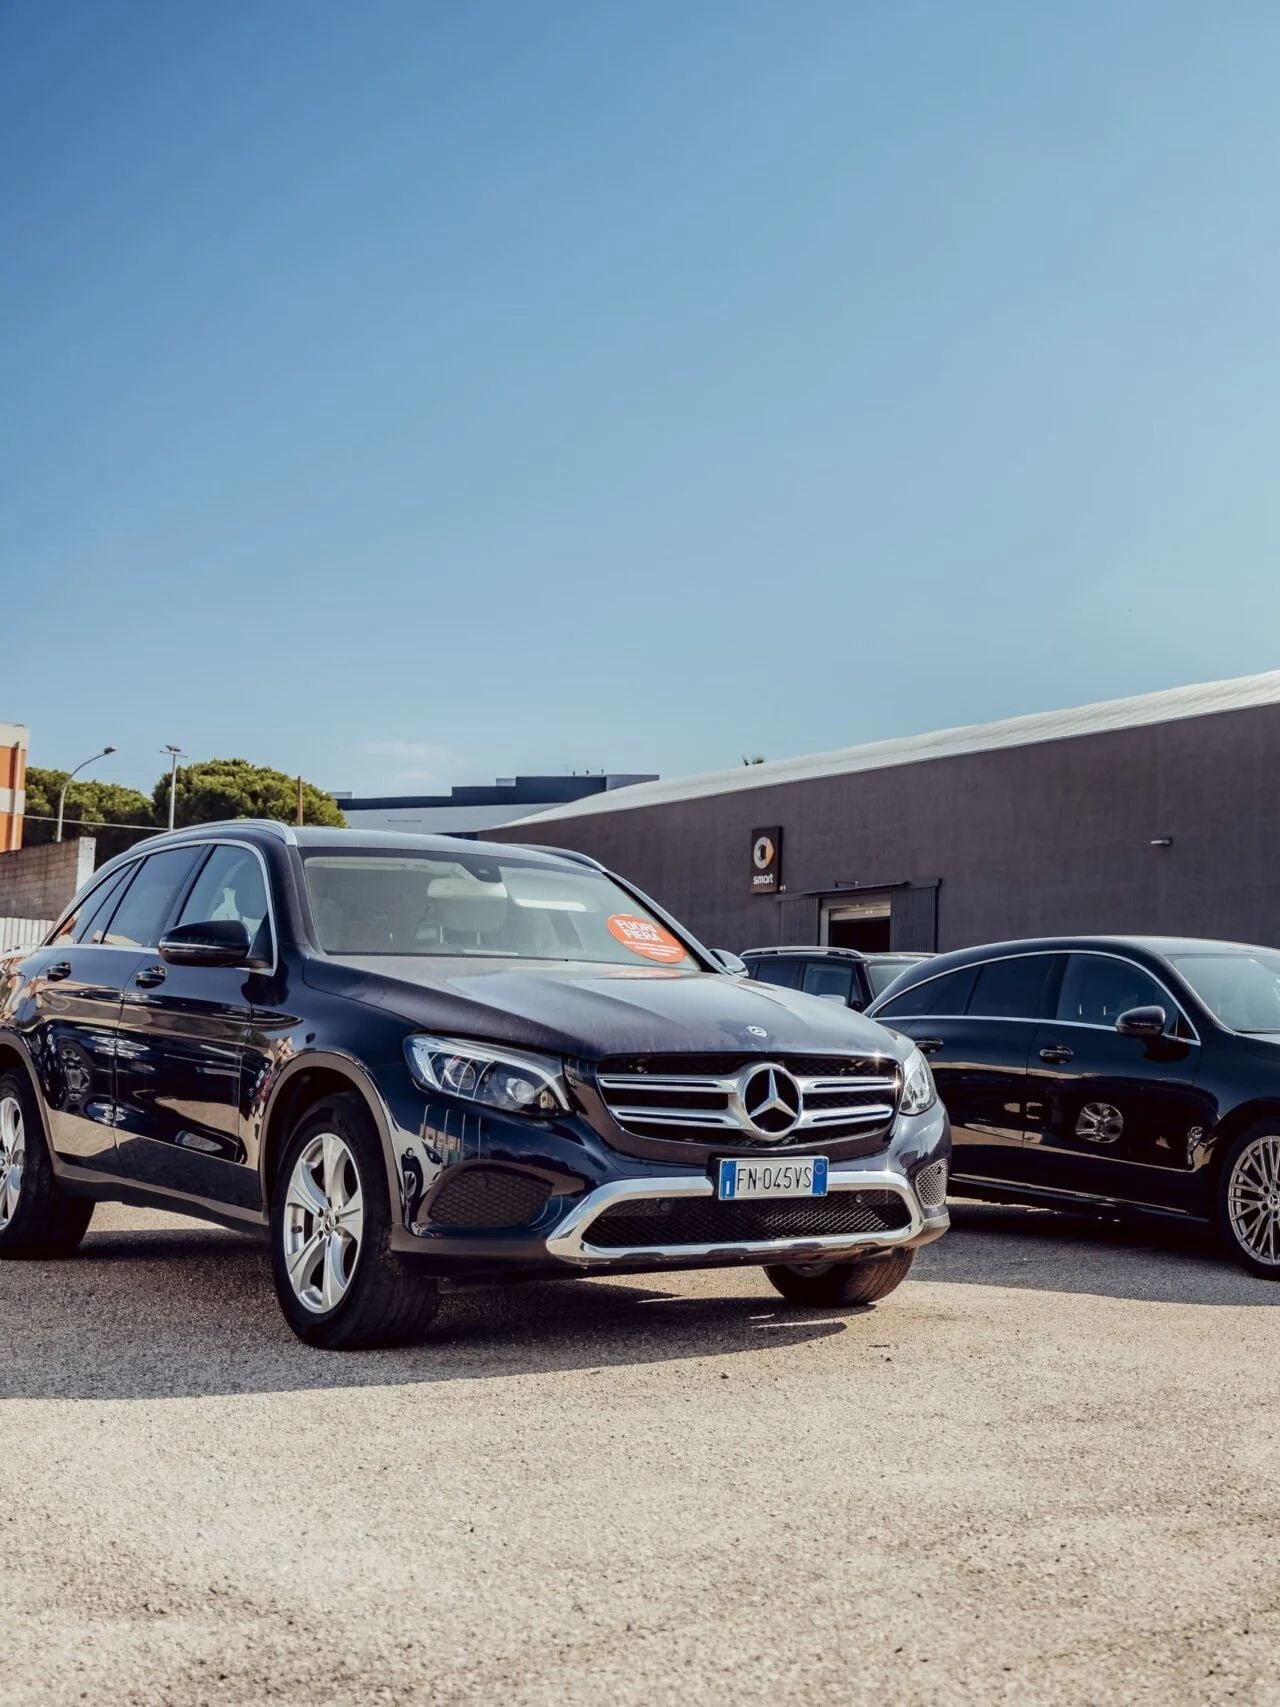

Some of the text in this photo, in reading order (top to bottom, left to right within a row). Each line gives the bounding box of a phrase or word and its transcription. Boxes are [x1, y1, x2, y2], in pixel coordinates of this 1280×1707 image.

[753, 873, 774, 885] smart
[614, 919, 657, 934] FUORI
[621, 928, 664, 943] FIERA
